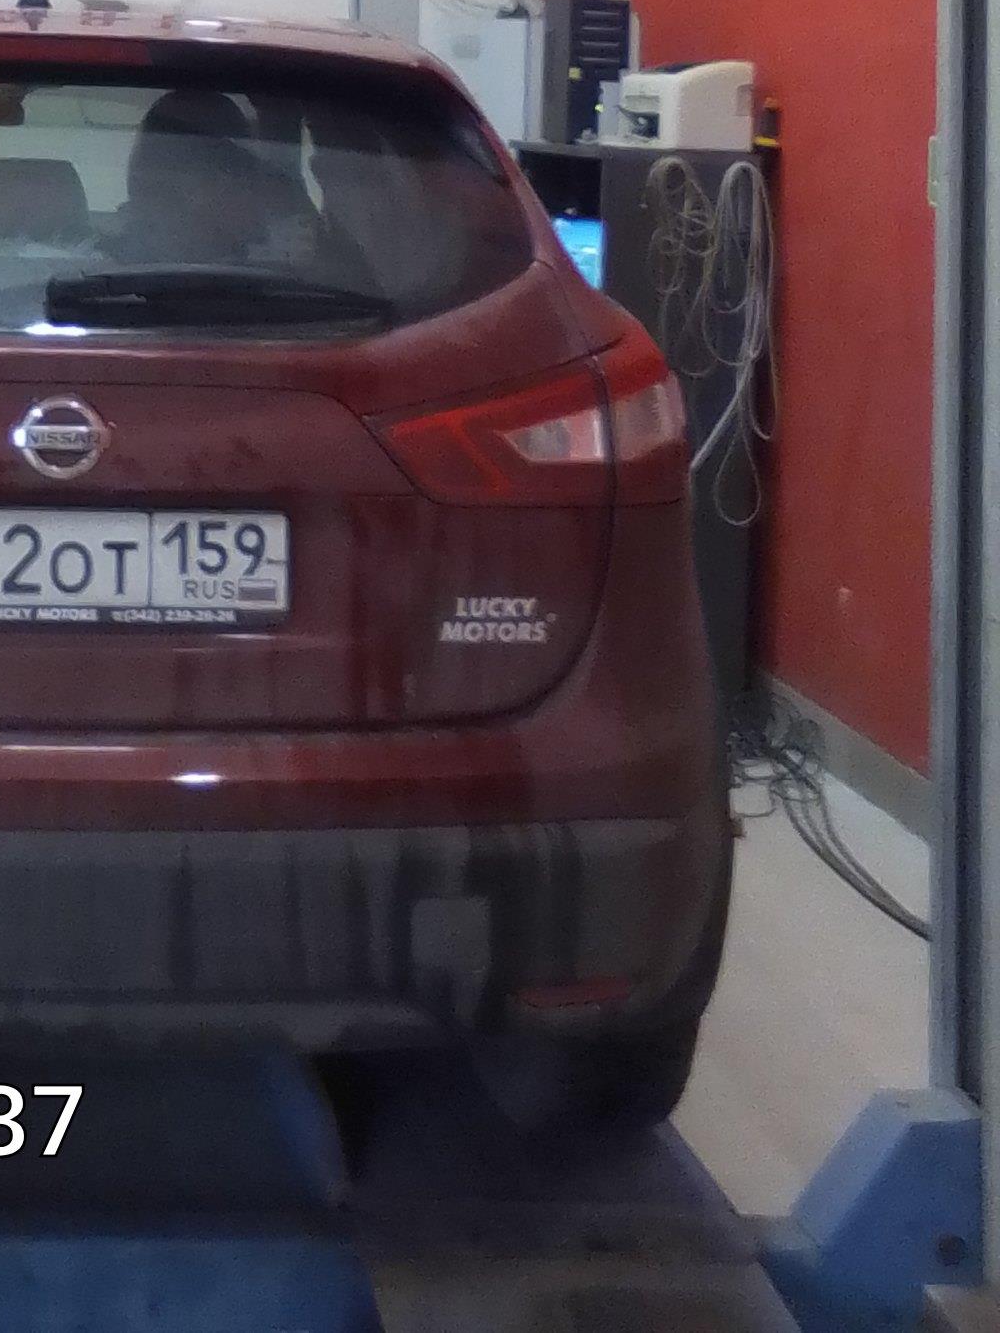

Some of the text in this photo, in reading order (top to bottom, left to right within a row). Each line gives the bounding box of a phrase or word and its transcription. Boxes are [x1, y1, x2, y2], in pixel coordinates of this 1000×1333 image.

[161, 521, 266, 576] 159
[183, 580, 235, 601] RUS
[456, 597, 537, 617] LUCKY
[440, 621, 547, 642] MOTORS
